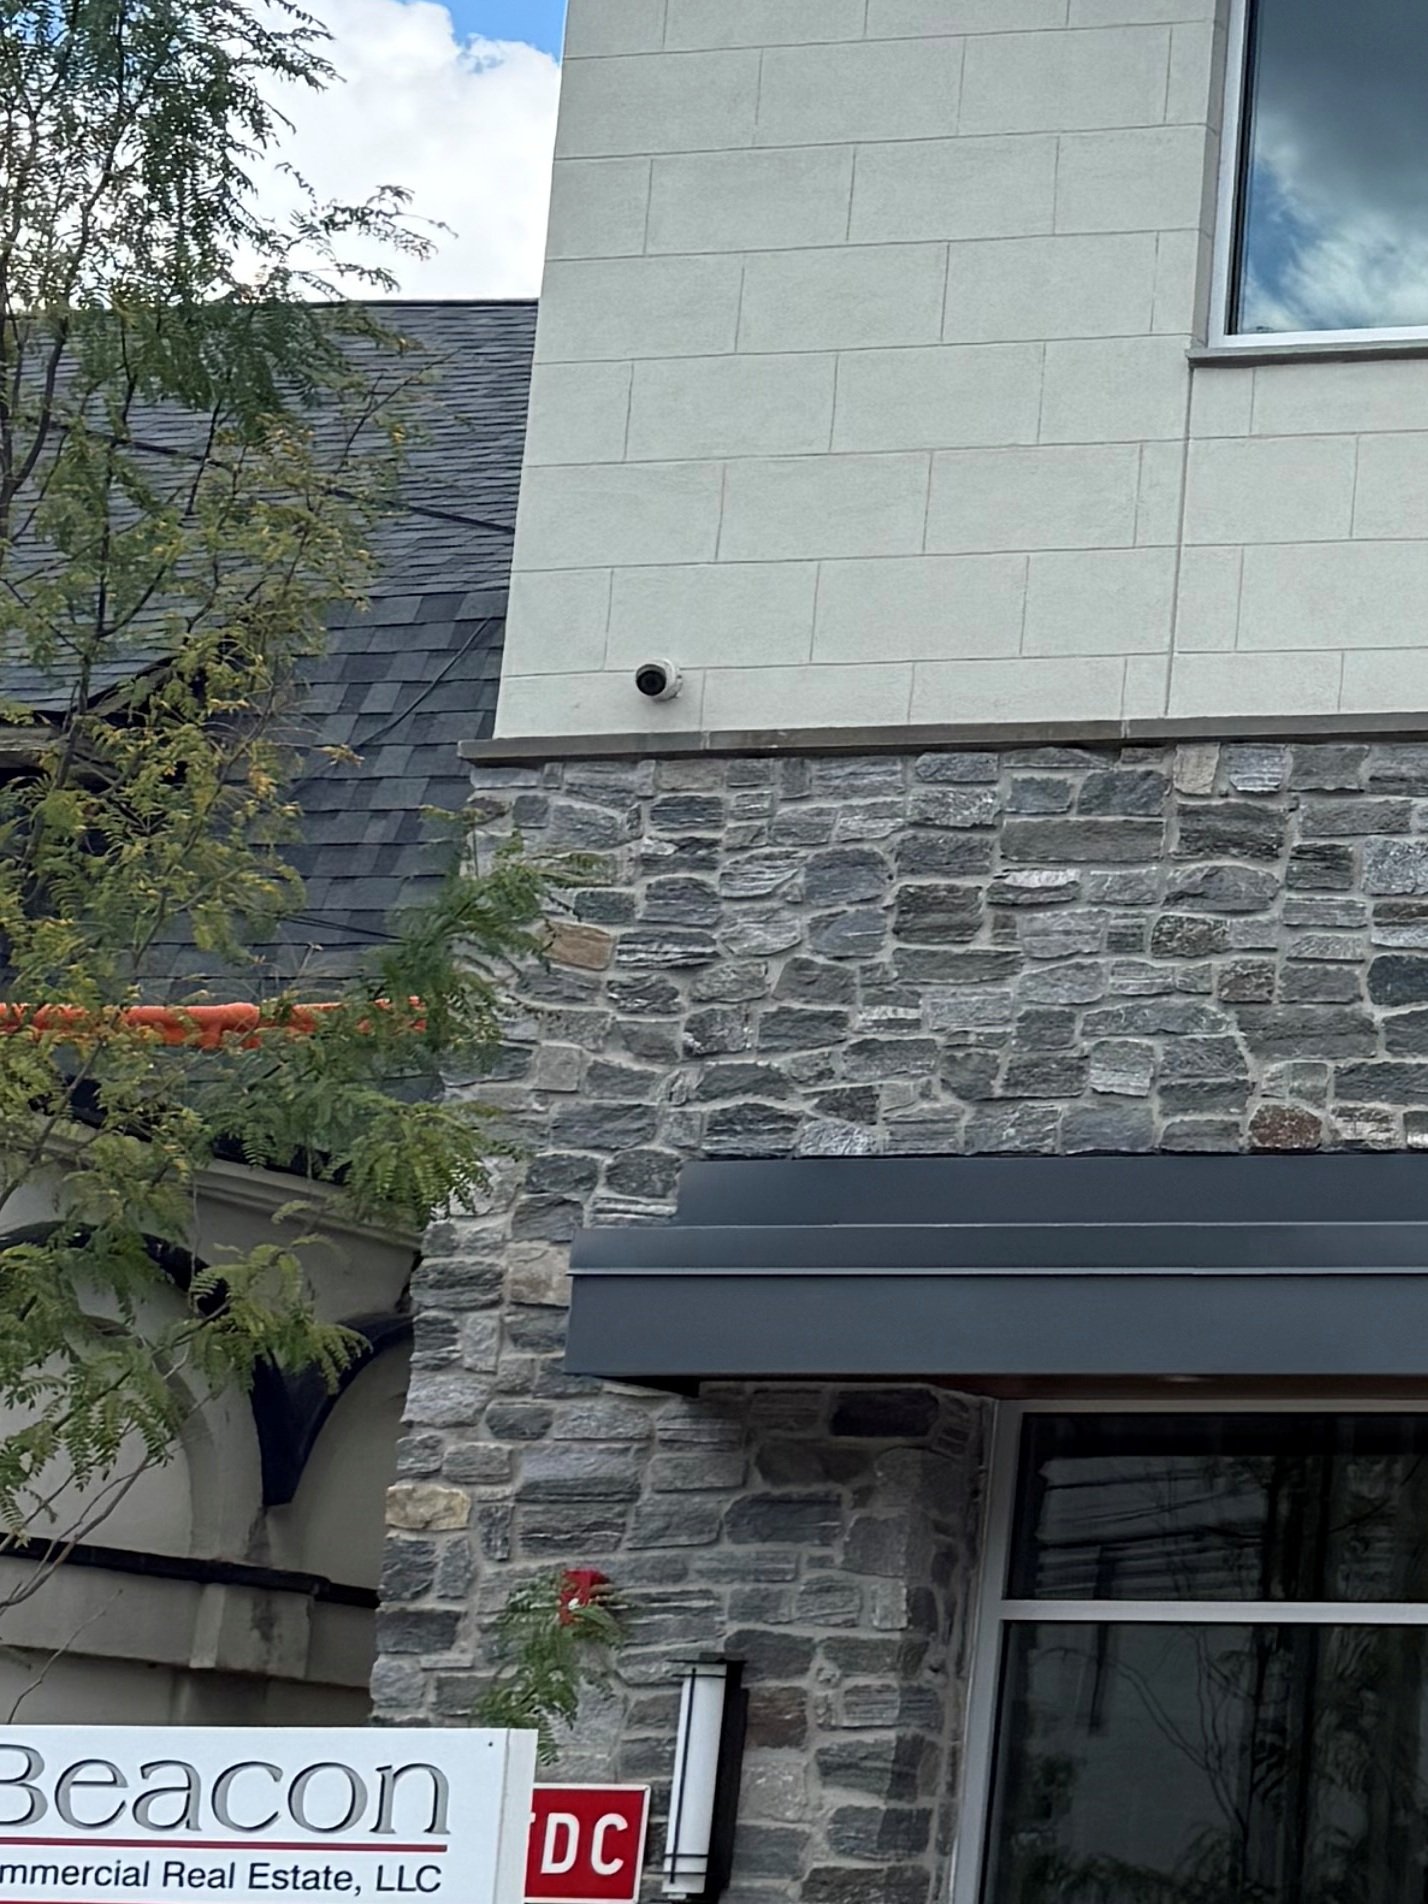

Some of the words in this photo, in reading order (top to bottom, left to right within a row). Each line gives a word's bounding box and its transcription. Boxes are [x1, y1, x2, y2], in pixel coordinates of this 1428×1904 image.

[0, 1744, 451, 1834] Beacon
[530, 1812, 629, 1875] DC
[162, 1861, 236, 1889] Real
[248, 1862, 362, 1897] Estate,
[376, 1864, 442, 1892] LLC
